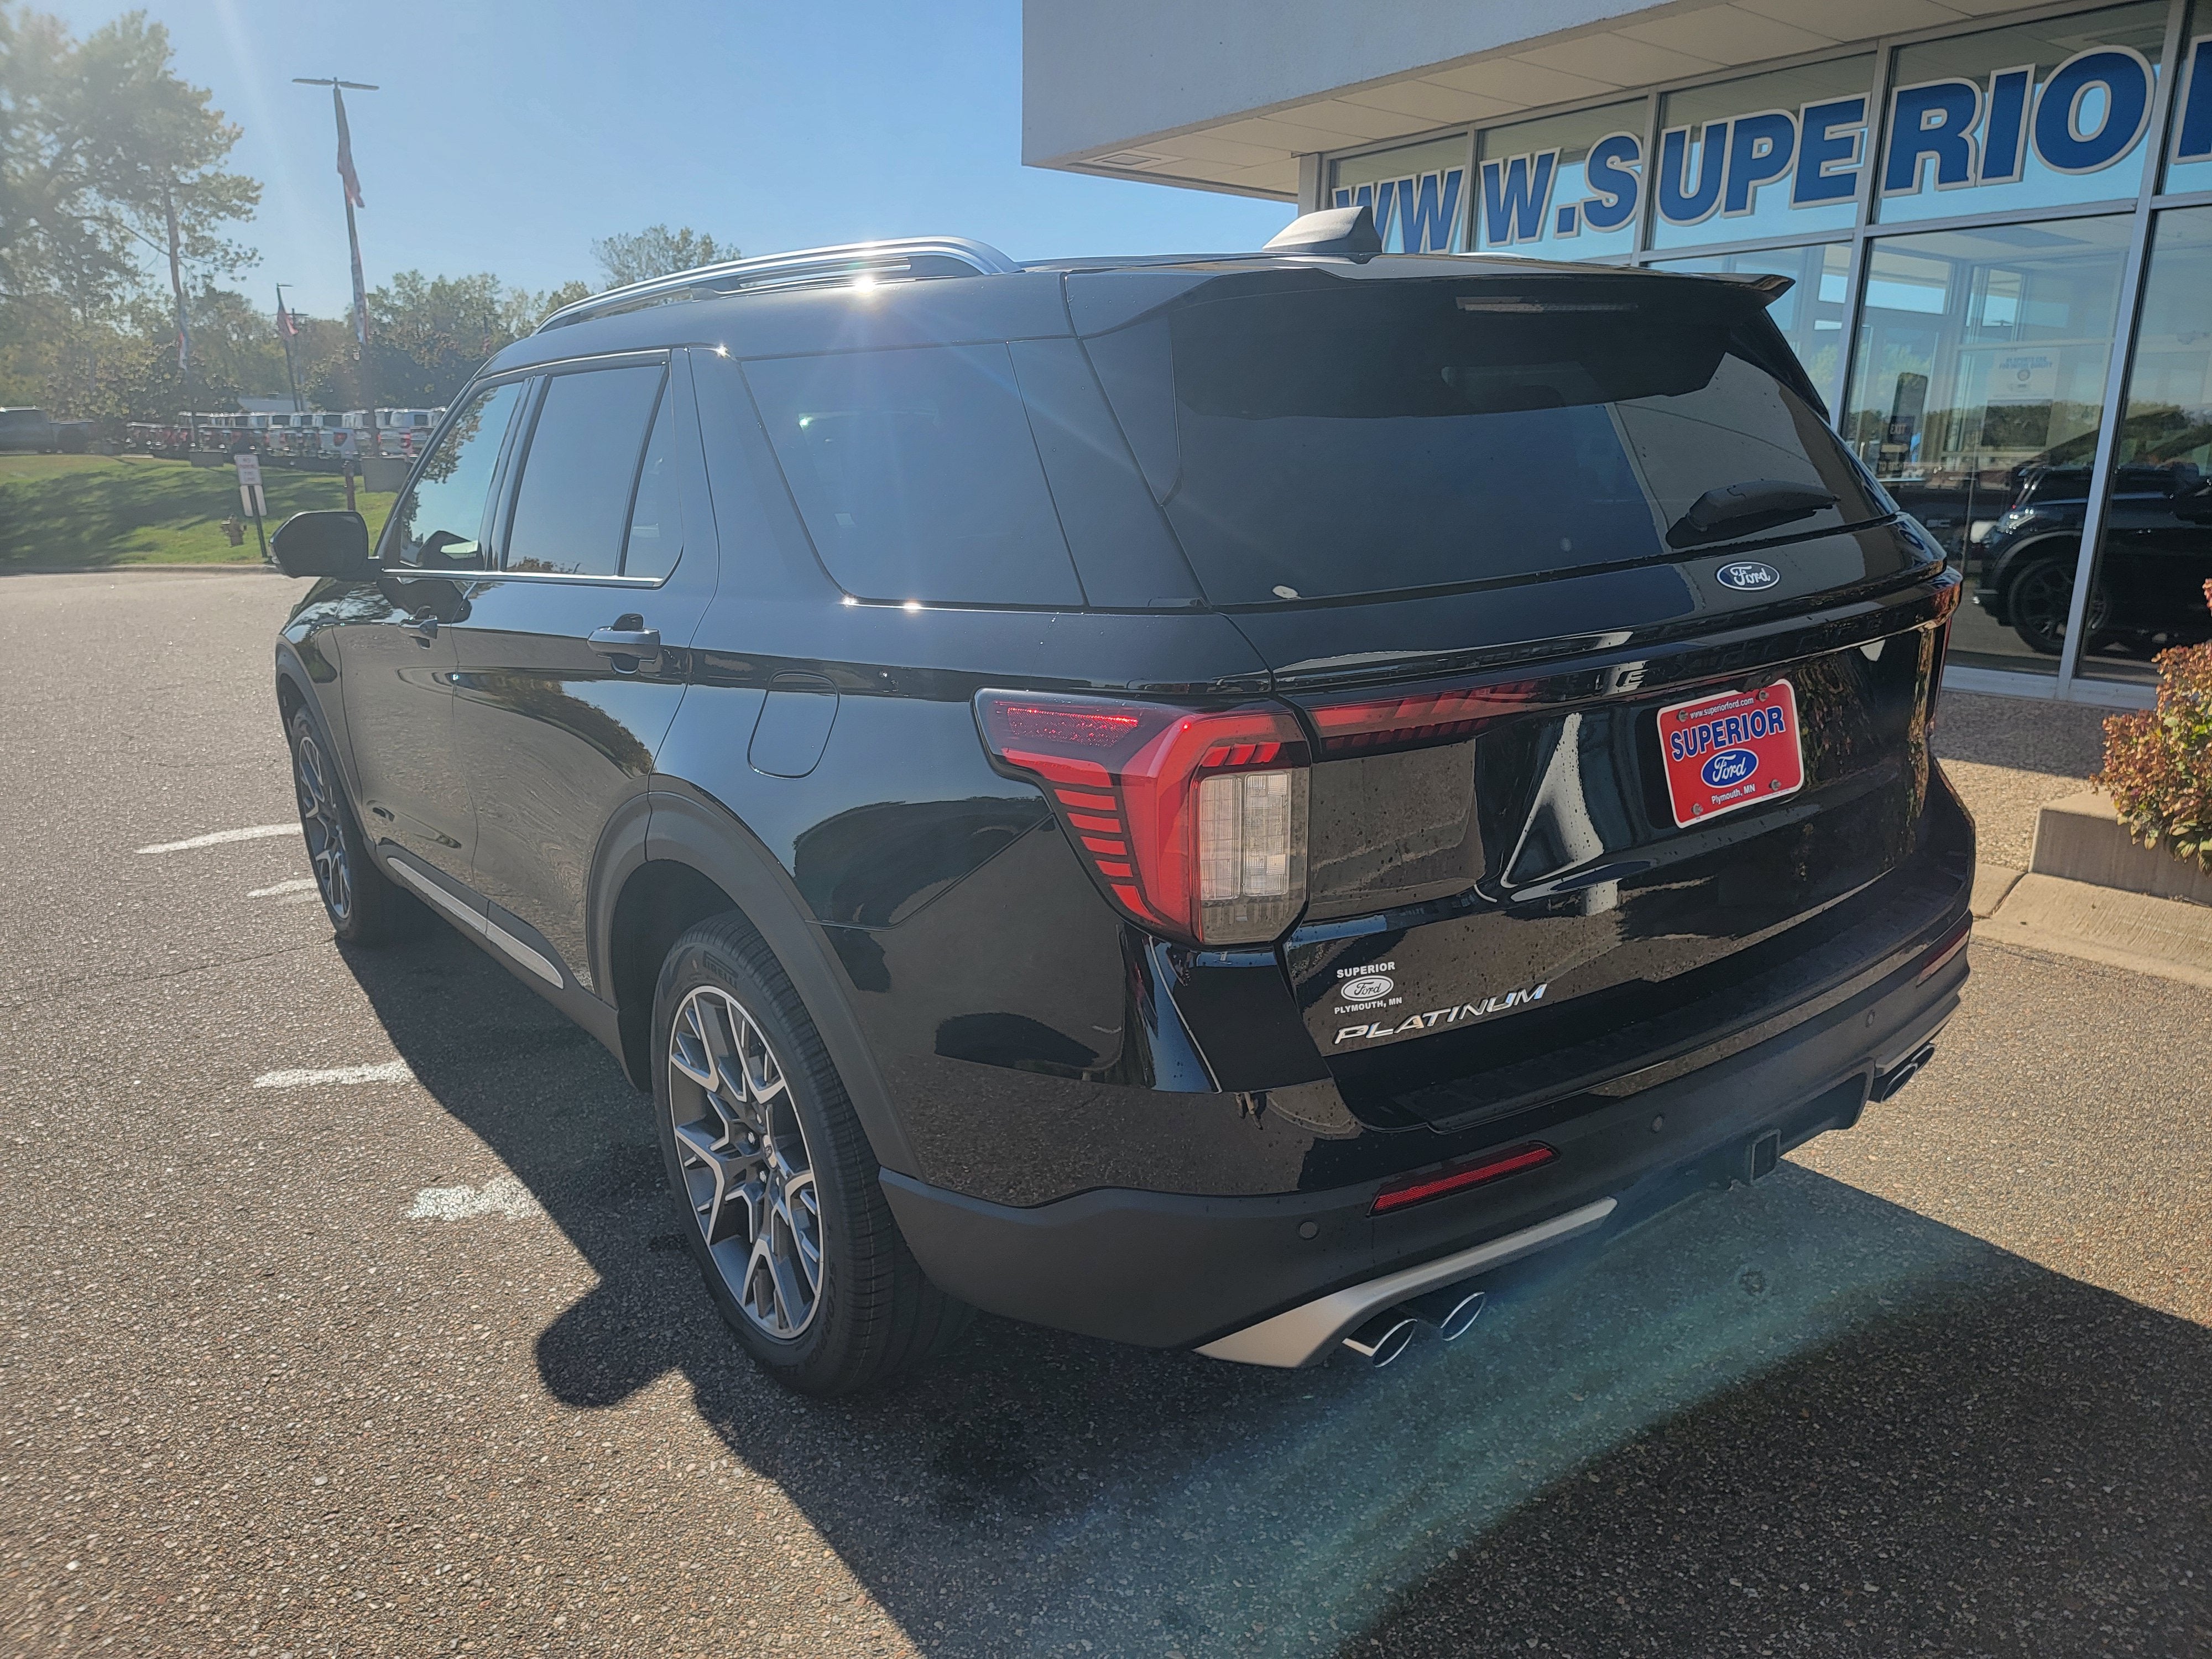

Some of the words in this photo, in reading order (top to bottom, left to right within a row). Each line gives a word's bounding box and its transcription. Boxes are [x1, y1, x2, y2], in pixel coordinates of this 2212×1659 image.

[1730, 566, 1771, 586] Ford
[1690, 697, 1754, 719] www.superiorford.com
[1670, 706, 1787, 761] SUPERIOR
[1712, 754, 1747, 782] Ford
[1711, 788, 1743, 805] Plymouth,
[1744, 783, 1756, 794] MN
[1336, 961, 1396, 978] SUPERIOR
[1354, 982, 1382, 995] Ford
[1332, 983, 1548, 1045] PLATINUM
[1334, 1000, 1387, 1014] PLYMOUTH,
[1389, 997, 1402, 1006] MN
